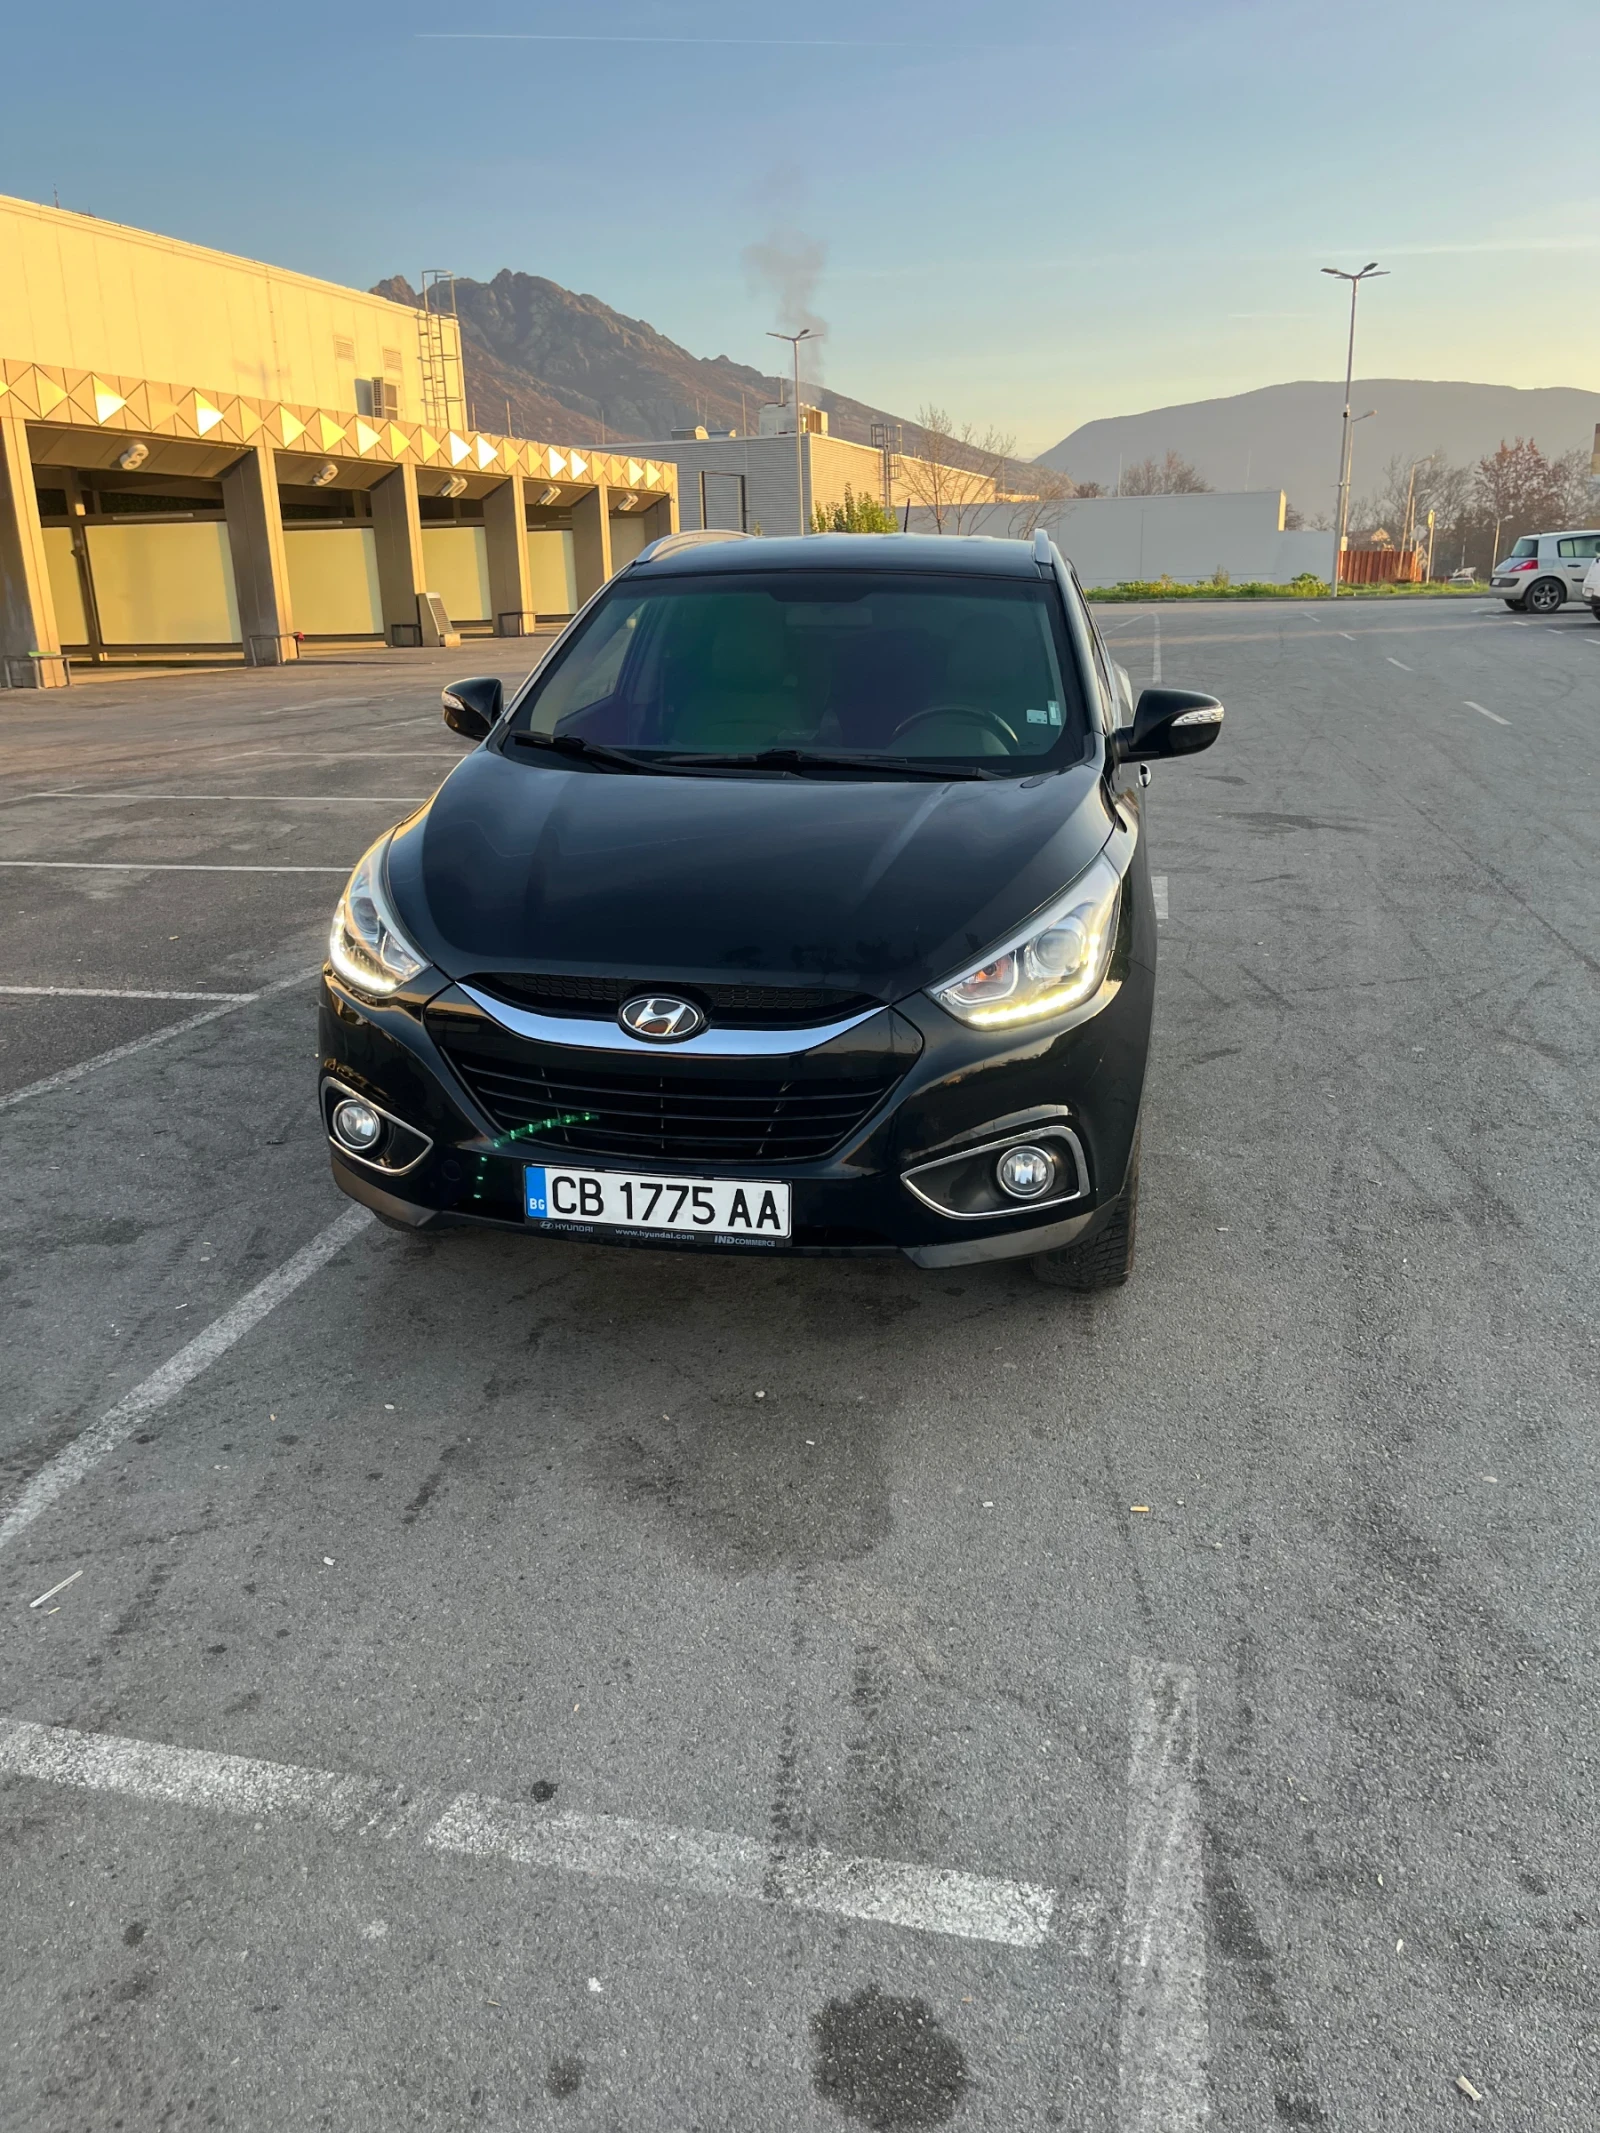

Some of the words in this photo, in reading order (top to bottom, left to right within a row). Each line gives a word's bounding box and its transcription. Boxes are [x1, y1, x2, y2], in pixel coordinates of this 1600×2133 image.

[121, 443, 149, 470] 8
[314, 464, 339, 486] 9
[441, 475, 468, 498] 10
[529, 1197, 546, 1211] BG
[551, 1175, 605, 1217] CB
[619, 1181, 716, 1225] 1775
[727, 1188, 781, 1230] AA
[554, 1222, 594, 1233] HYUNDAI
[614, 1228, 695, 1241] www.hyundai.com
[714, 1235, 776, 1247] INDCOMMERCE
